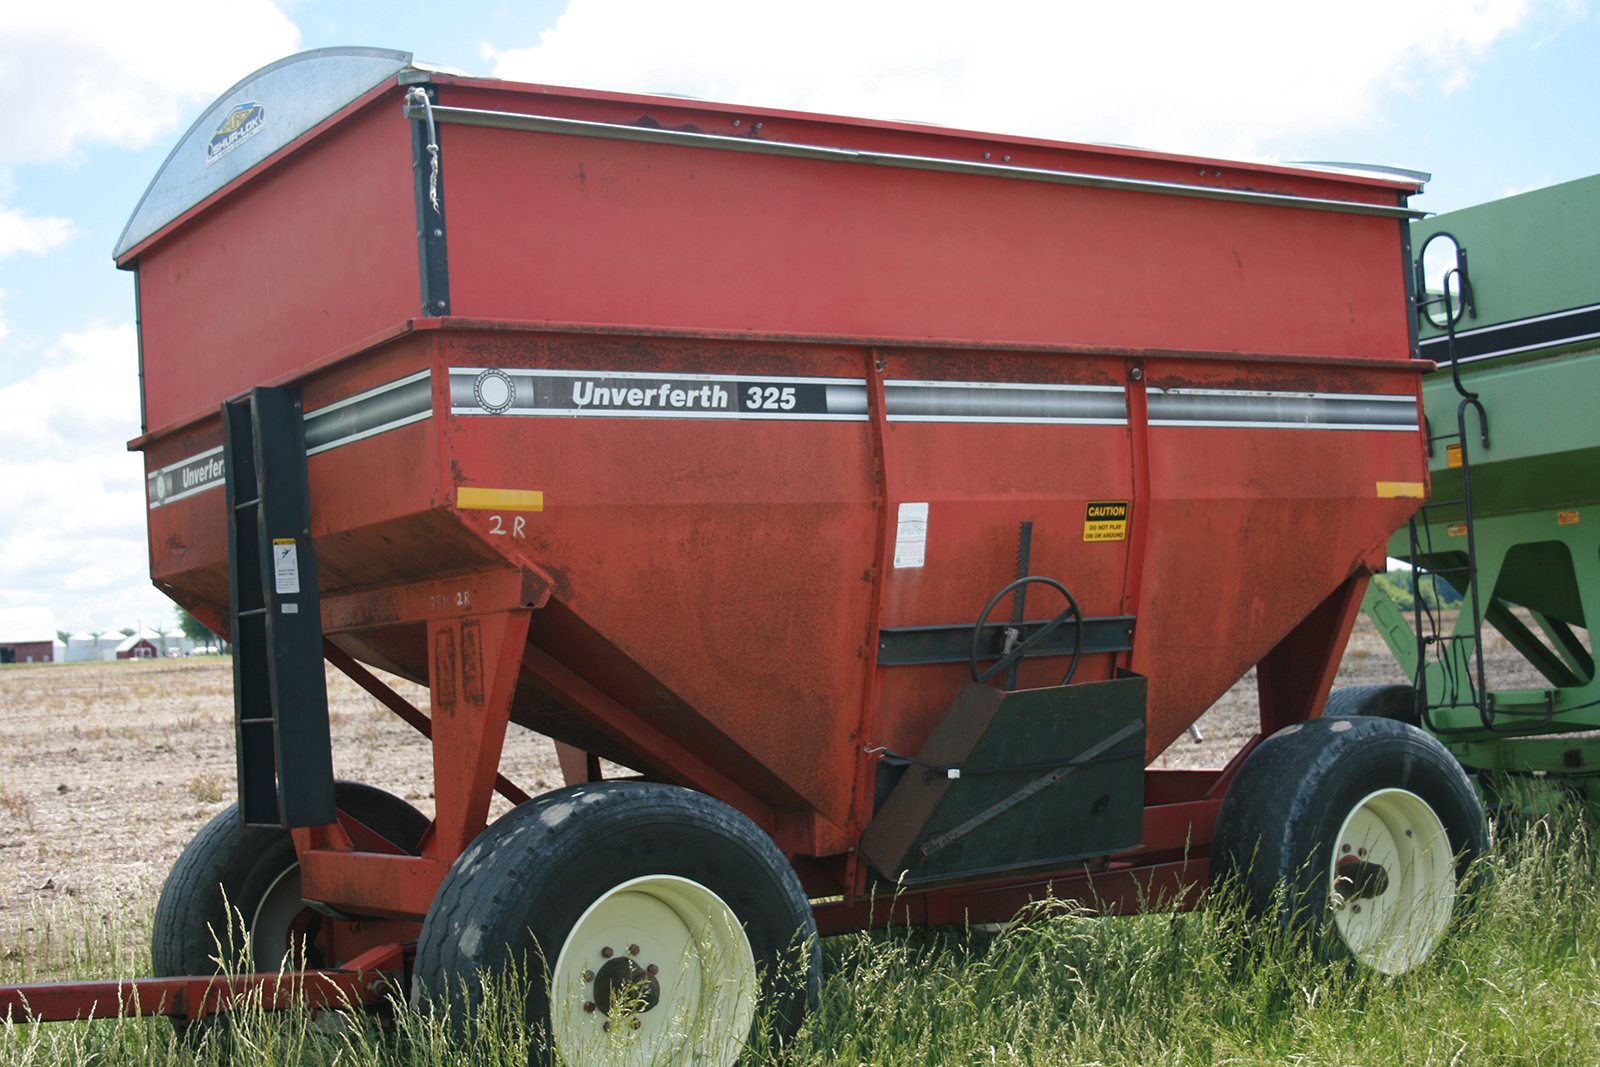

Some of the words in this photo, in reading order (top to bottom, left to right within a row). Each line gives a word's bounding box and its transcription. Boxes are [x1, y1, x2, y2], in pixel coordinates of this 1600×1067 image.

[572, 381, 728, 408] Unverferth
[746, 386, 796, 409] 325
[183, 458, 225, 488] Unverfer
[1088, 506, 1125, 517] CAUTION
